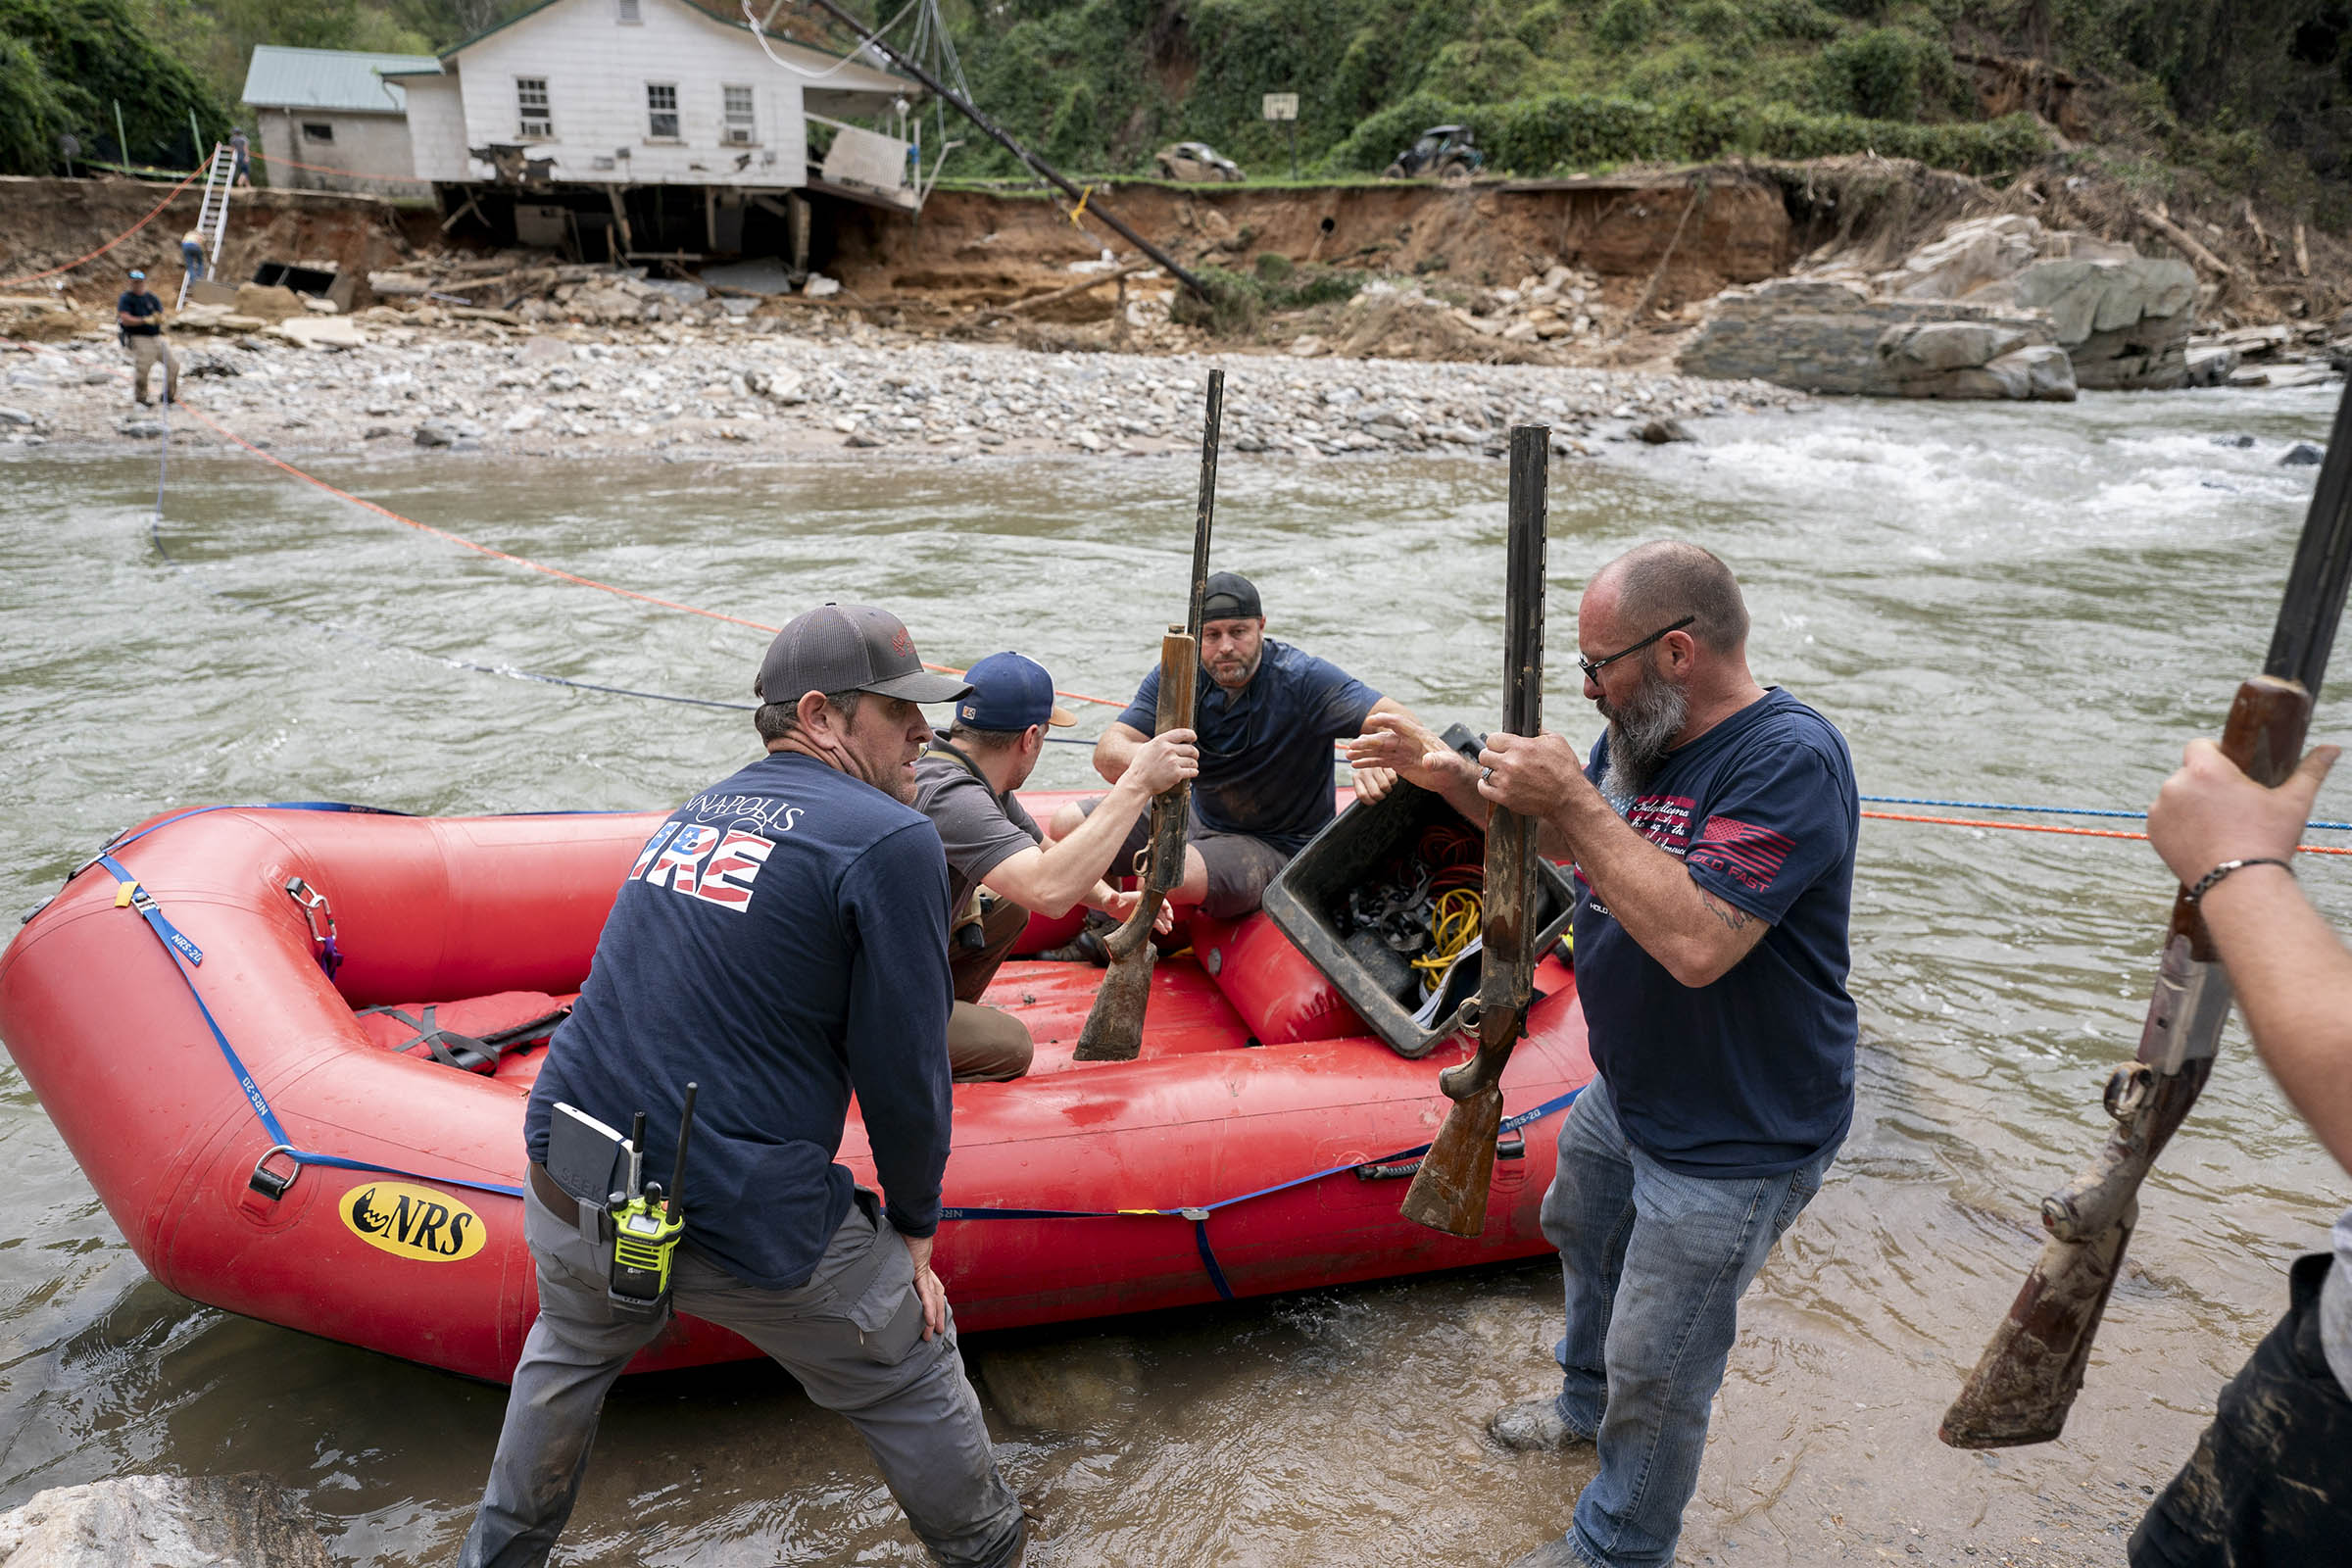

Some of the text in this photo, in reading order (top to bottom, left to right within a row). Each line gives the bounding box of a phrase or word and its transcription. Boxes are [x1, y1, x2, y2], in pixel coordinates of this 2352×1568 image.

[1728, 865, 1770, 893] FAST
[1590, 902, 1608, 914] HOLD
[171, 933, 203, 963] NRS-20
[242, 1076, 269, 1116] NRS-20
[1505, 1108, 1542, 1130] NRS-20
[562, 1167, 604, 1198] SEEK
[380, 1195, 472, 1255] NRS
